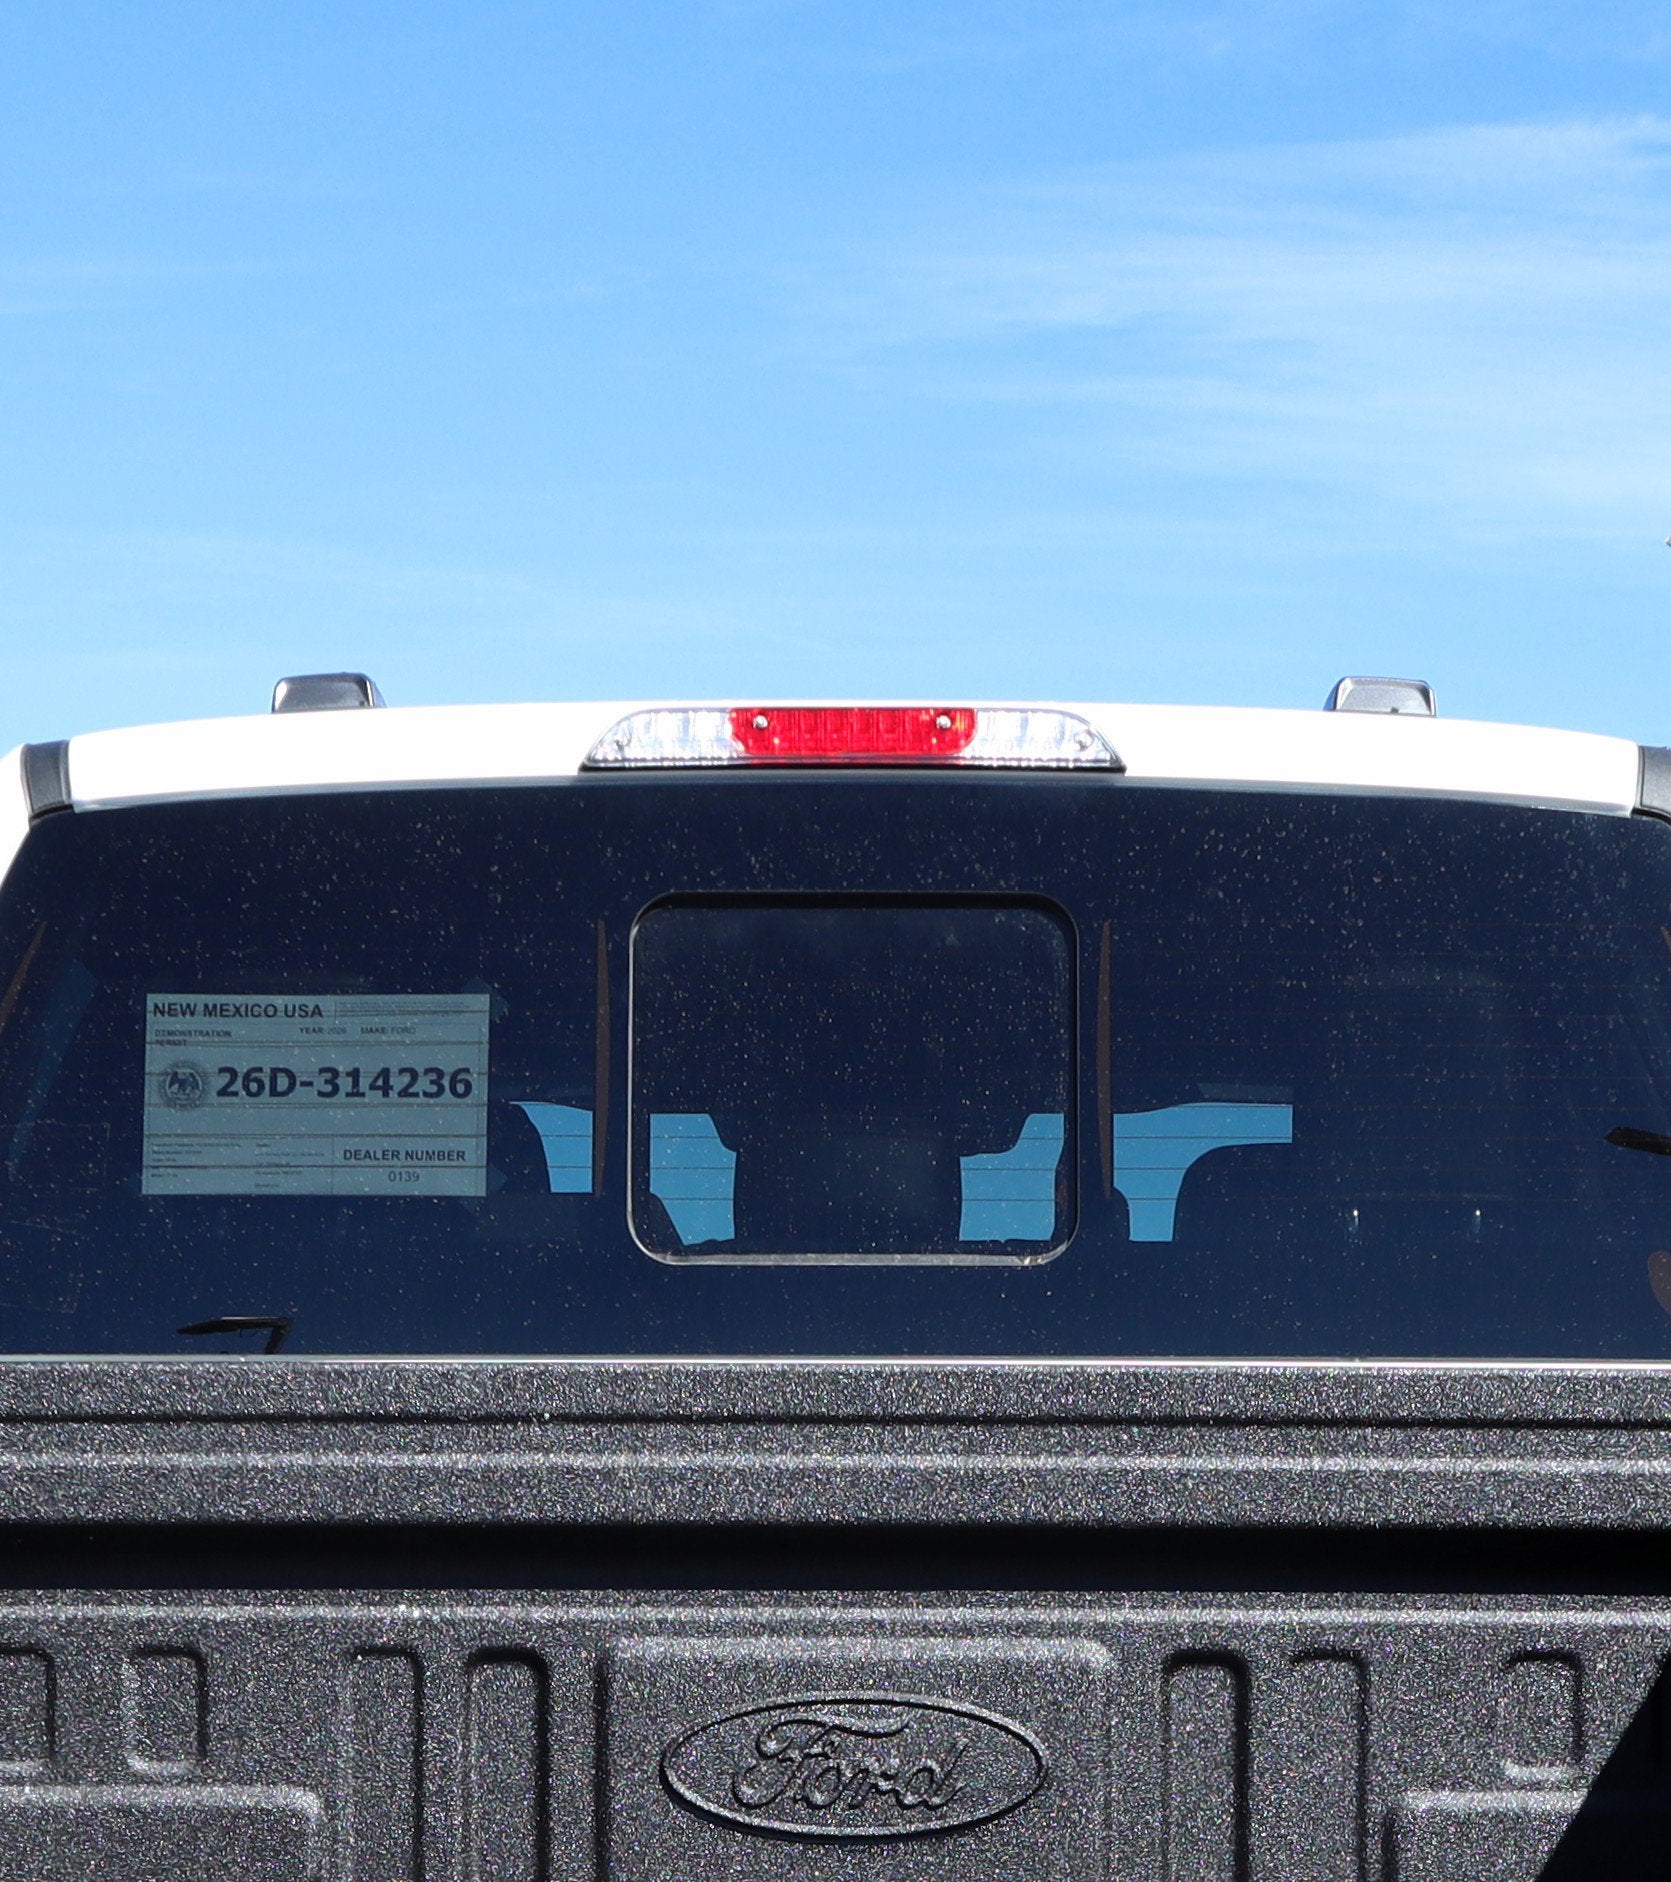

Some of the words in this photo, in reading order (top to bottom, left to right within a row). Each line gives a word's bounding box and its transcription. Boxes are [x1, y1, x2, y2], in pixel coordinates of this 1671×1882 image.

[152, 1002, 197, 1018] NEW
[203, 1003, 278, 1018] MEXICO
[284, 1003, 324, 1018] USA
[154, 1029, 232, 1038] DEMONSTRATION
[390, 1026, 417, 1035] FORD
[216, 1066, 473, 1099] 26D-314236
[343, 1149, 401, 1161] DEALER
[404, 1149, 466, 1162] NUMBER
[388, 1170, 420, 1182] 0139
[731, 1718, 970, 1810] Ford
